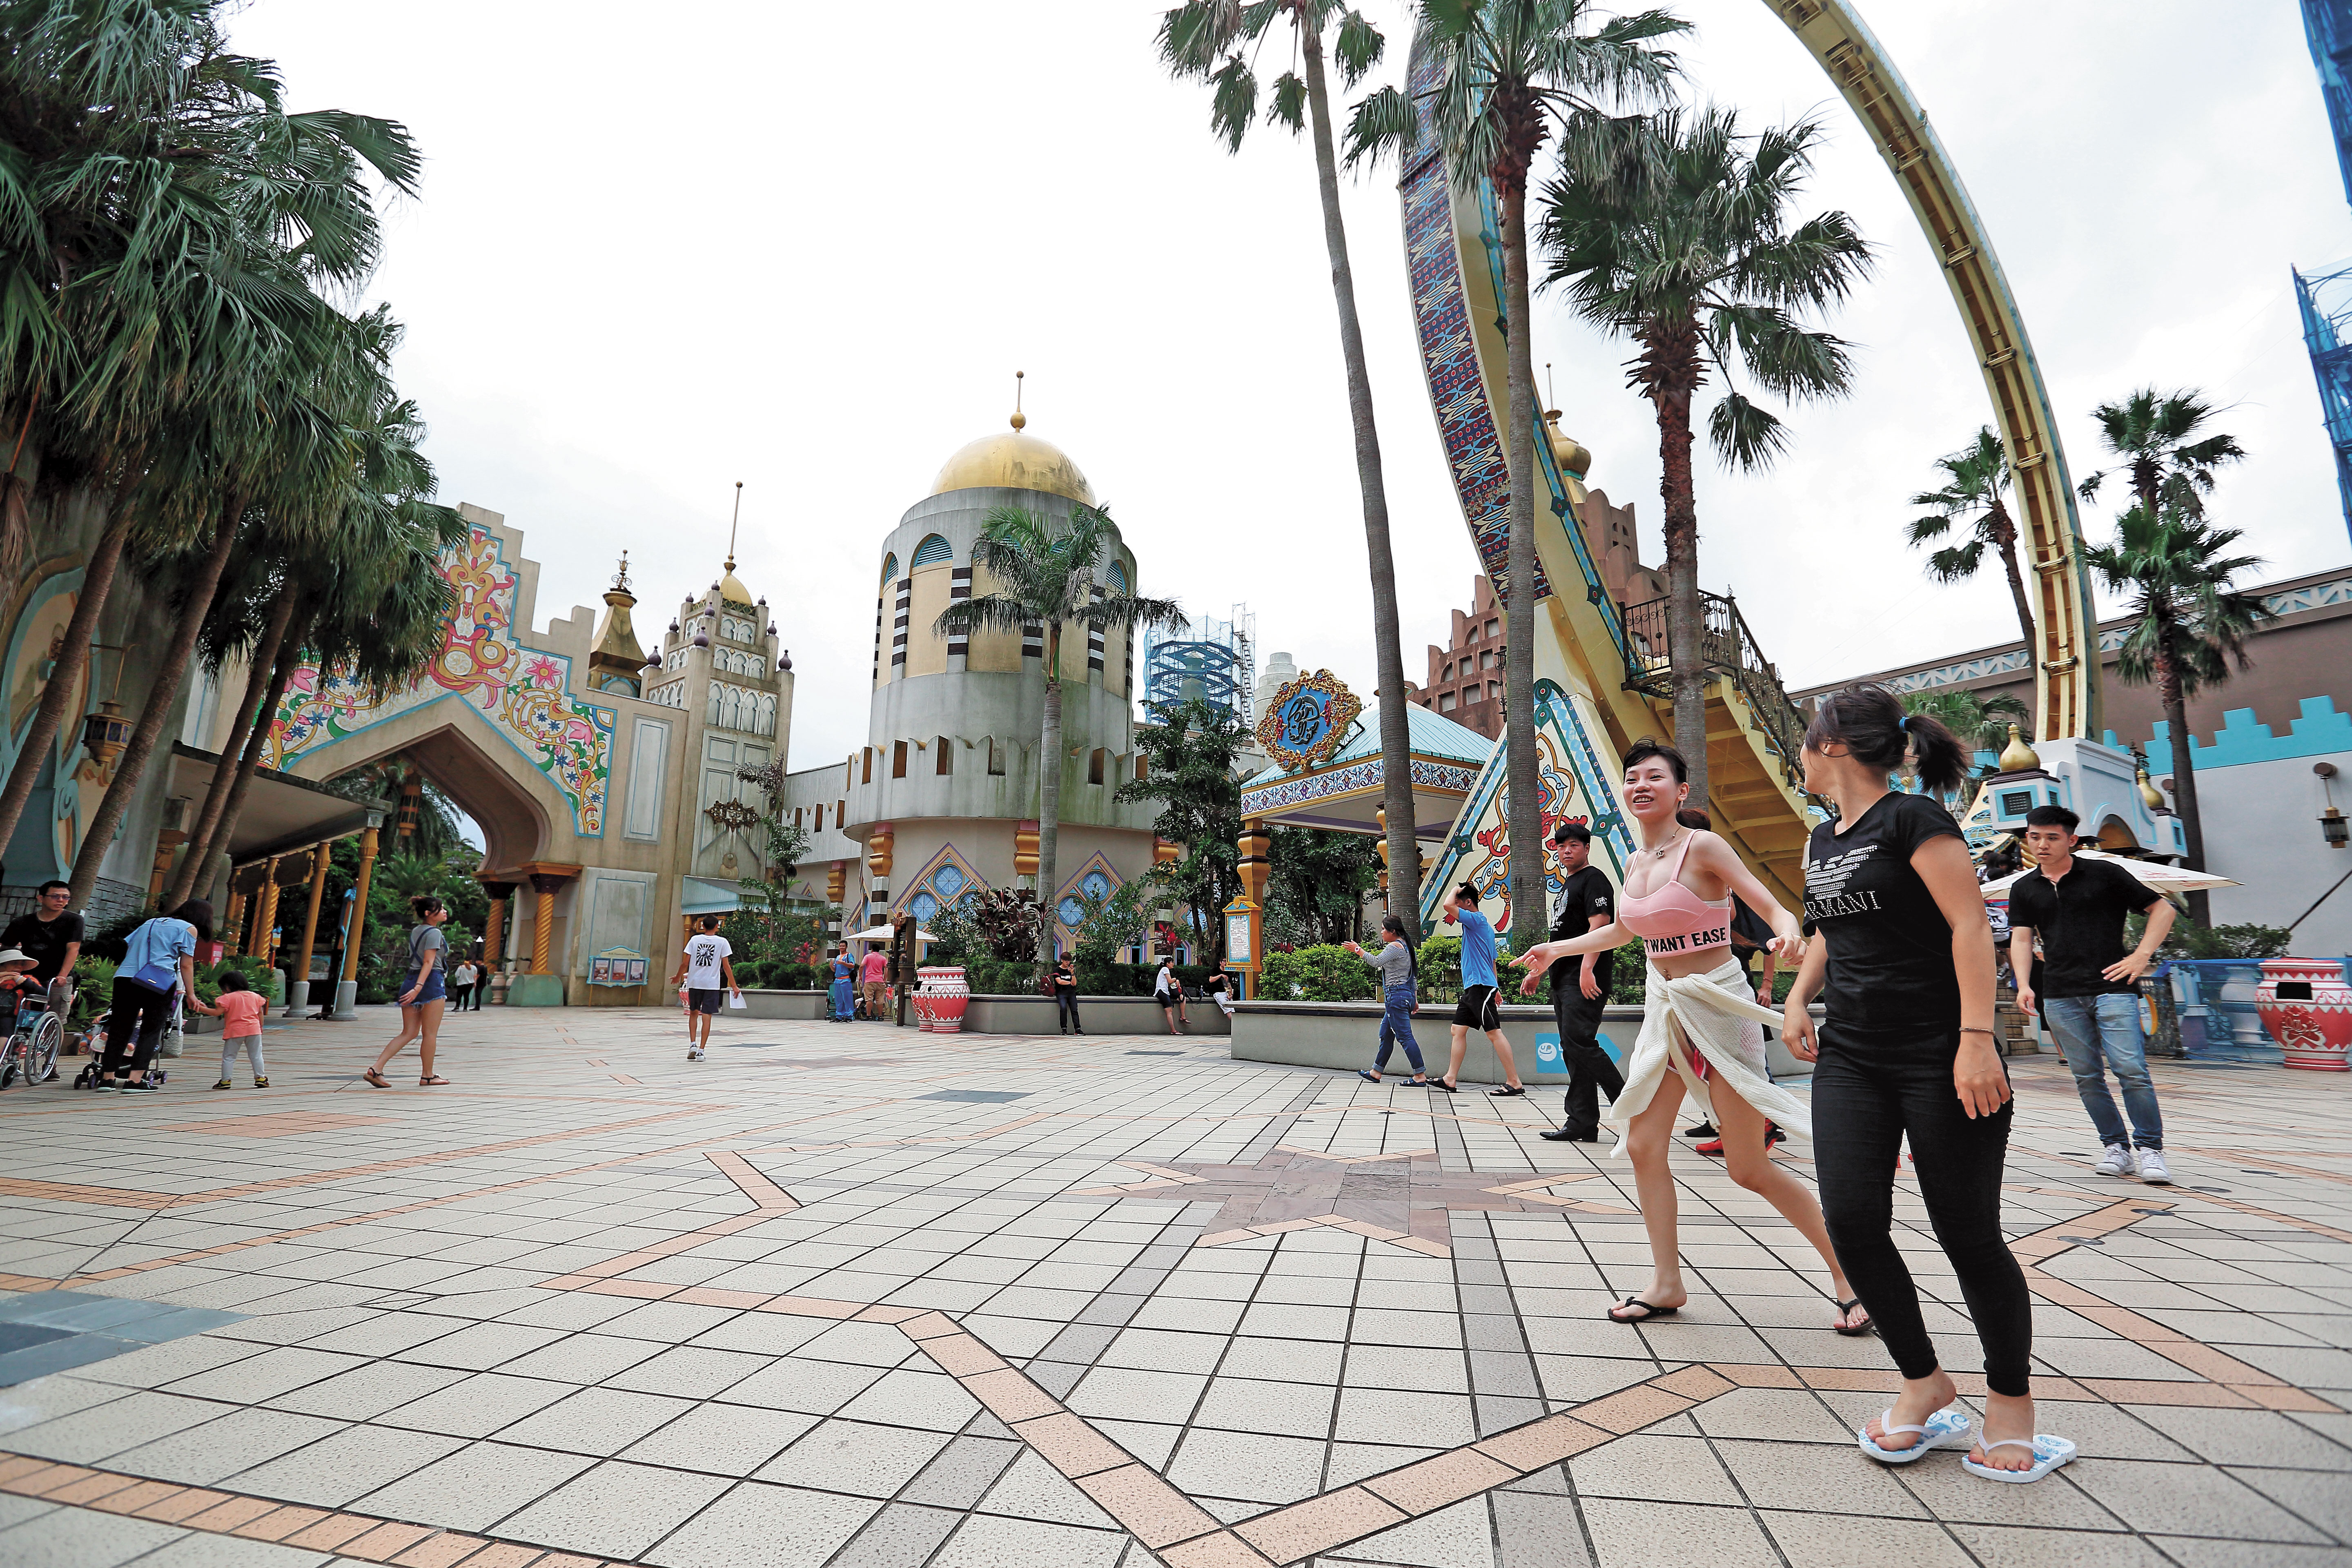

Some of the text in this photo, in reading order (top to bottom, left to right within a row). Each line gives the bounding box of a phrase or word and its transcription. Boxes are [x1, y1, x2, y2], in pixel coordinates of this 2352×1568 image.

[1806, 891, 1881, 920] RMANI
[1650, 935, 1686, 953] WANT
[1691, 927, 1726, 947] EASE
